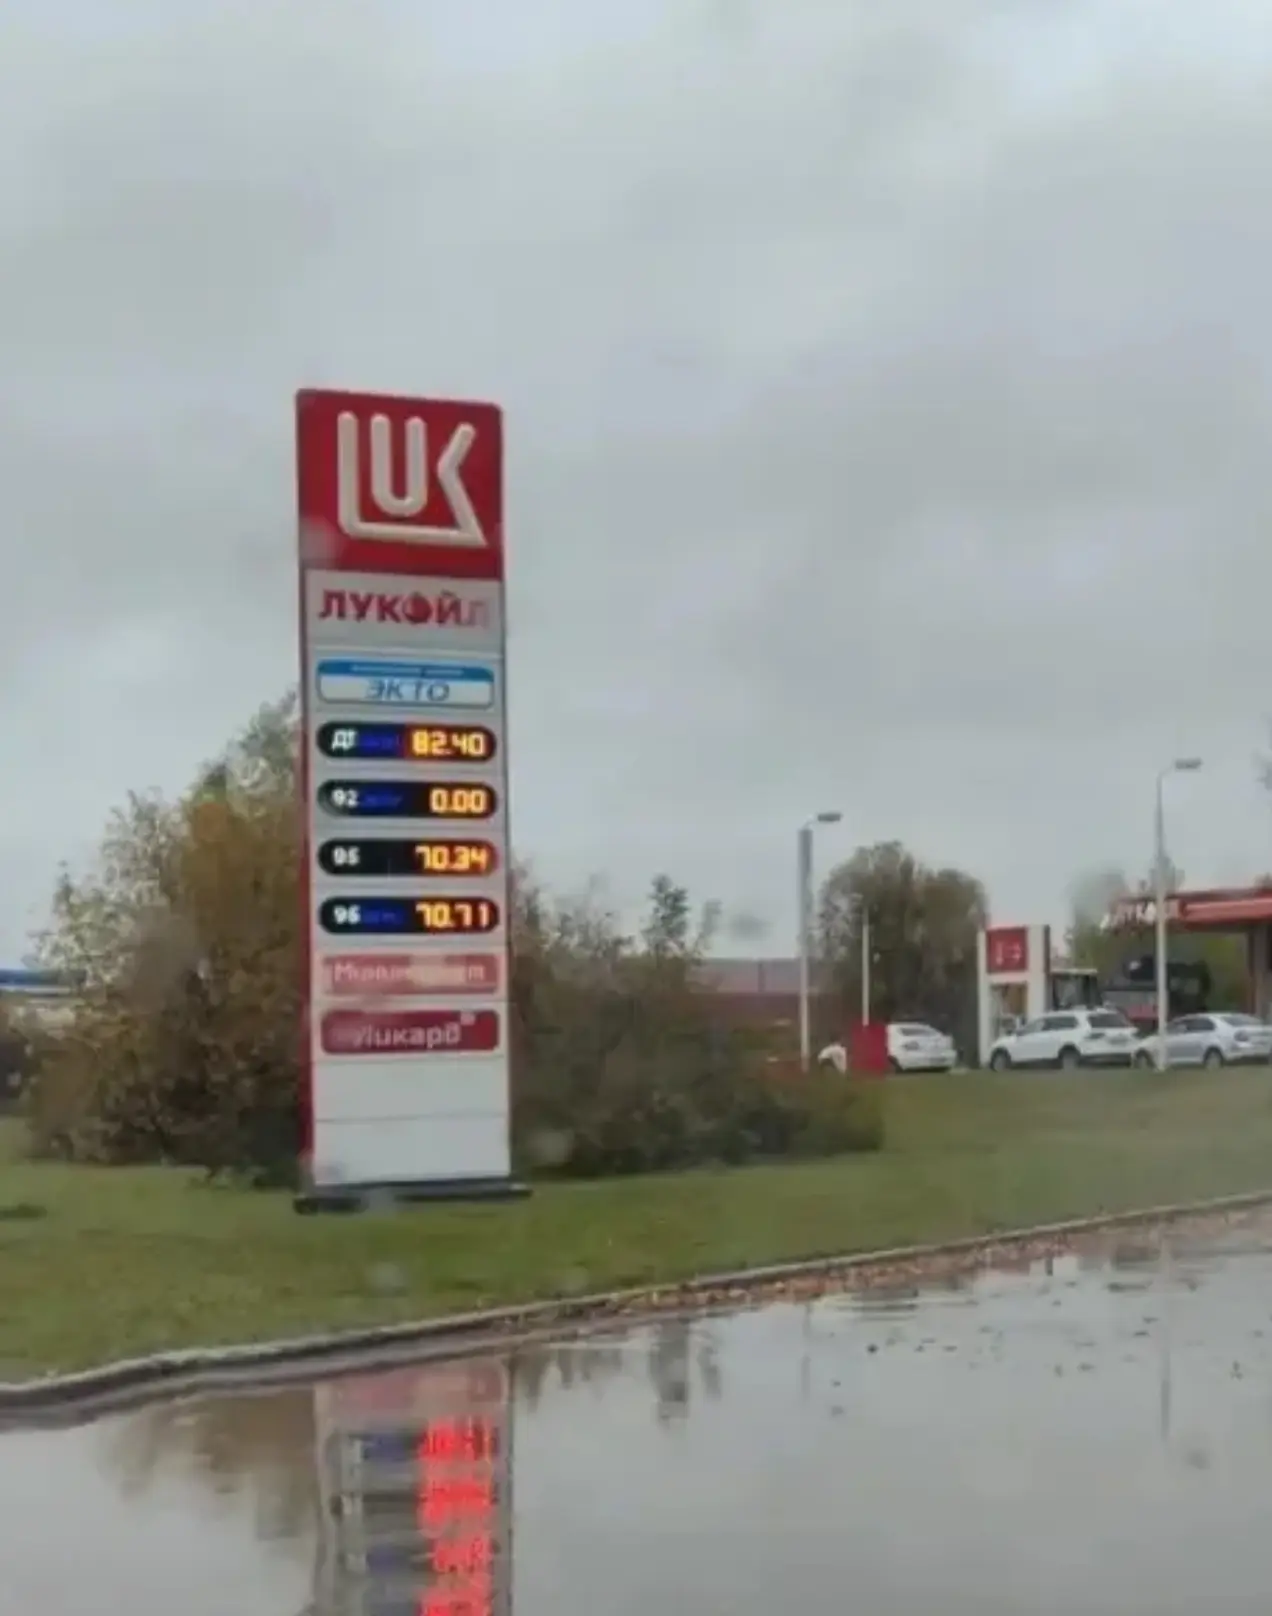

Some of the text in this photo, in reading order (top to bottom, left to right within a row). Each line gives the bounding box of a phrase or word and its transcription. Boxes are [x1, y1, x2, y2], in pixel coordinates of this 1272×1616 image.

[318, 588, 487, 629] ЛУКОЙЛ
[365, 678, 450, 702] ЭКТО
[331, 729, 359, 751] ДТ
[412, 730, 486, 756] 82.40
[430, 788, 486, 814] 0.00
[415, 845, 488, 871] 70.34
[416, 903, 490, 928] 70.71
